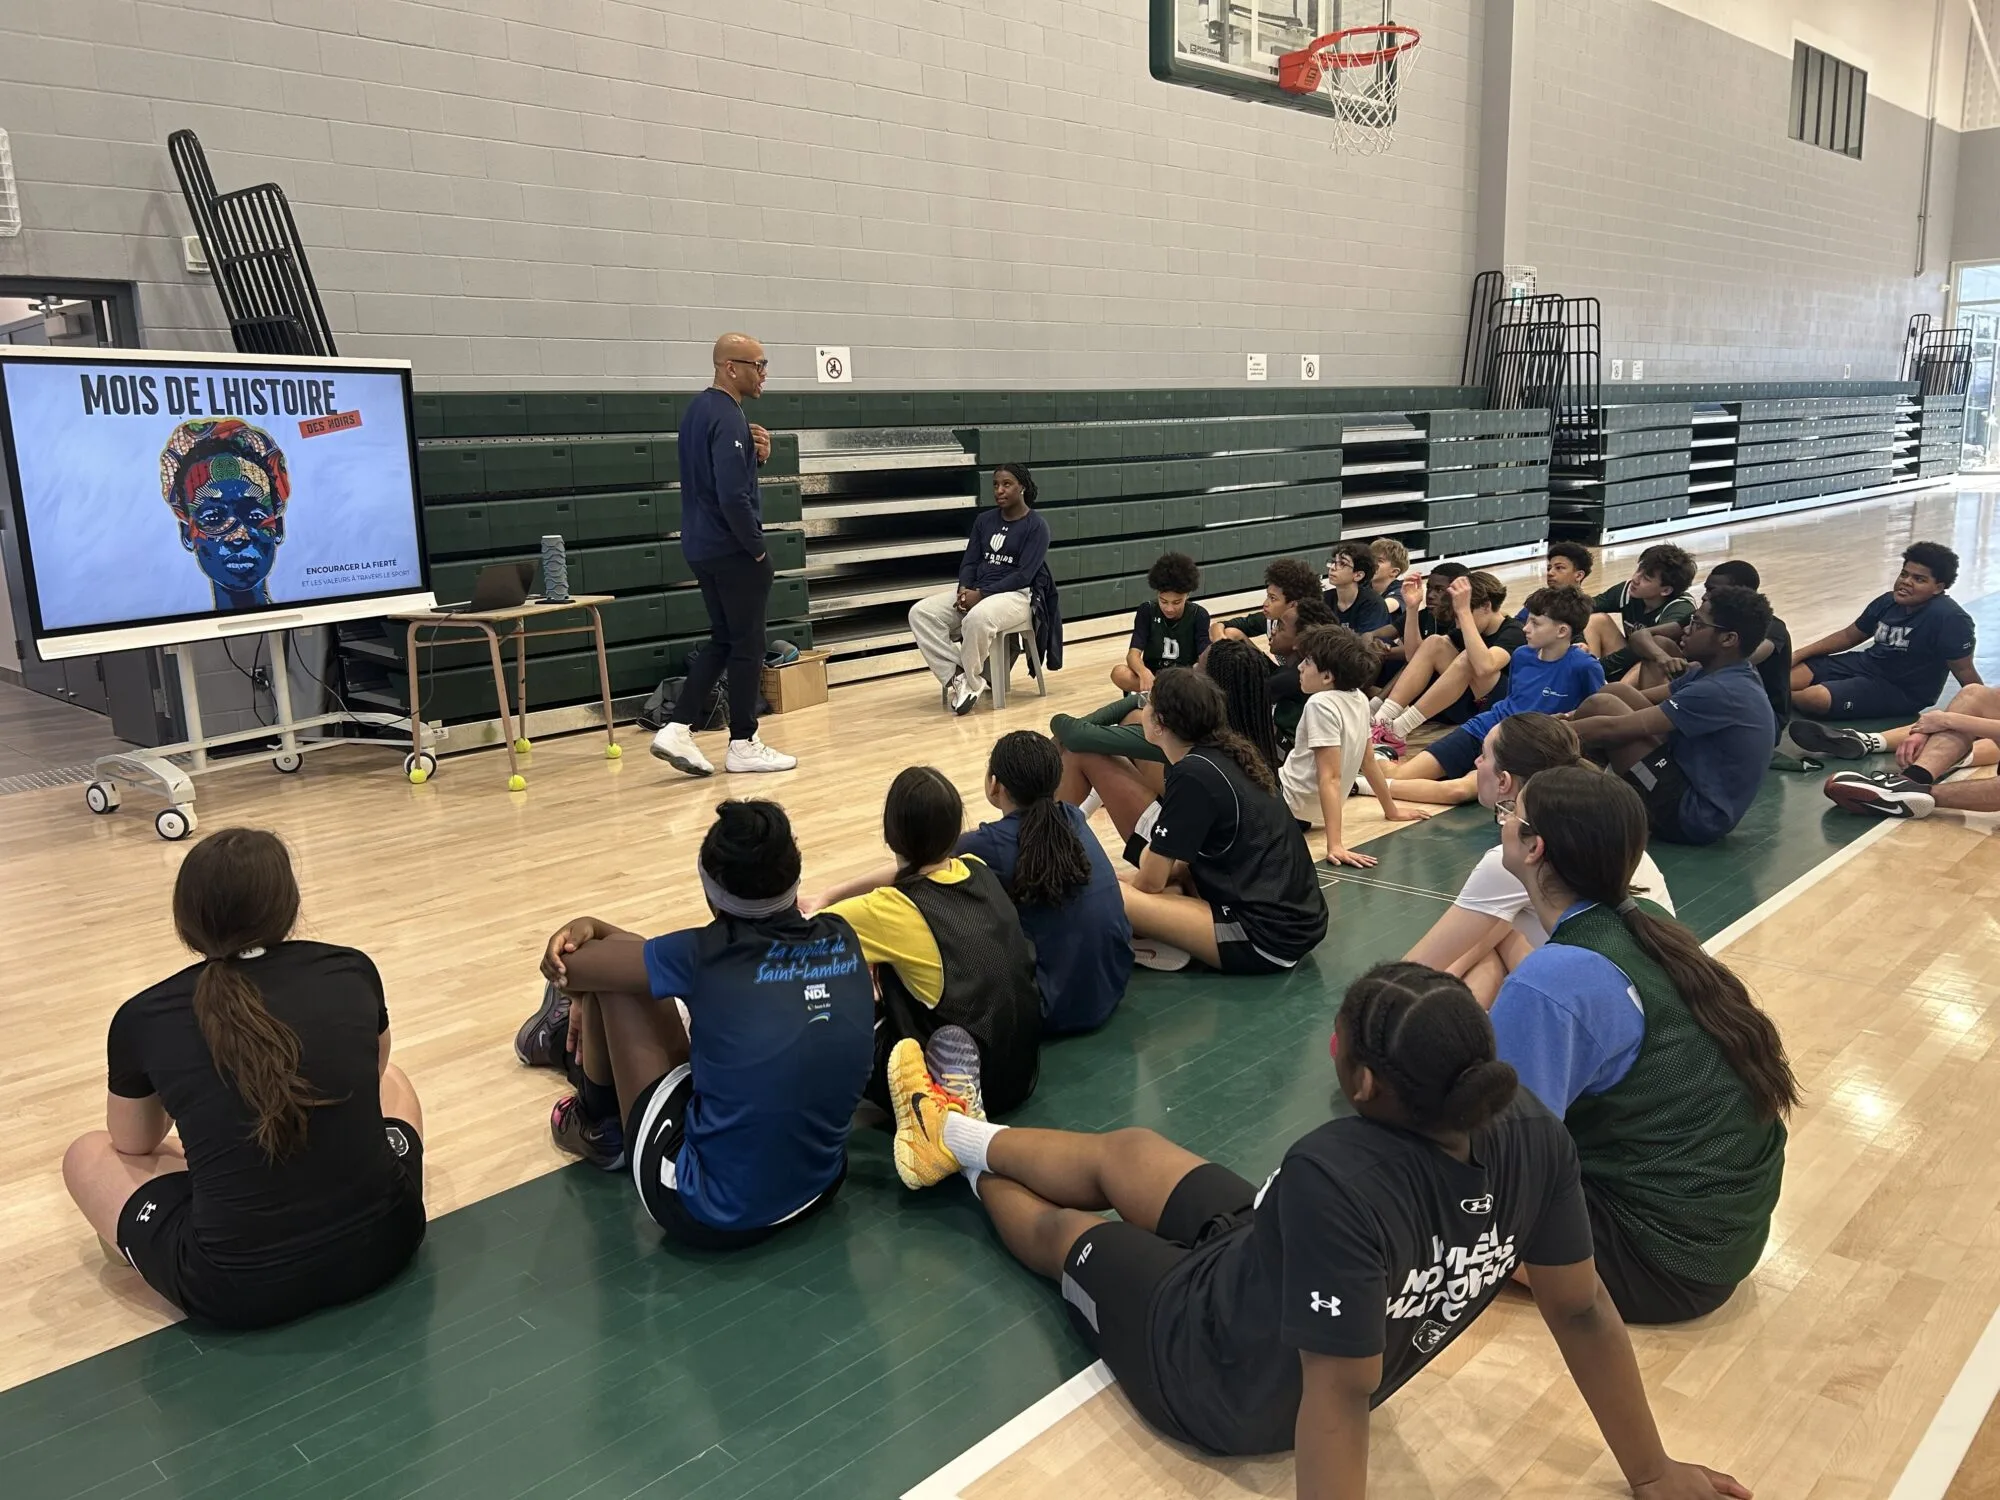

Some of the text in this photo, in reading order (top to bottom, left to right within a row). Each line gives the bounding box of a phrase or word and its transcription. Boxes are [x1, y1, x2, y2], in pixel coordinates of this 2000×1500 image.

[80, 374, 159, 415] MOIS
[164, 376, 203, 415] DE
[306, 415, 356, 434] DES NOIRS
[306, 558, 397, 575] ENCOURAGER LA FIERTÉ
[310, 579, 322, 587] LES
[323, 577, 351, 585] VALEURS
[357, 572, 383, 581] TRAVERS
[391, 569, 410, 577] SPORT
[1162, 636, 1180, 660] D
[766, 940, 787, 959] La
[831, 934, 846, 954] de
[754, 953, 859, 984] Saint-Lambert
[804, 988, 830, 1001] NDL
